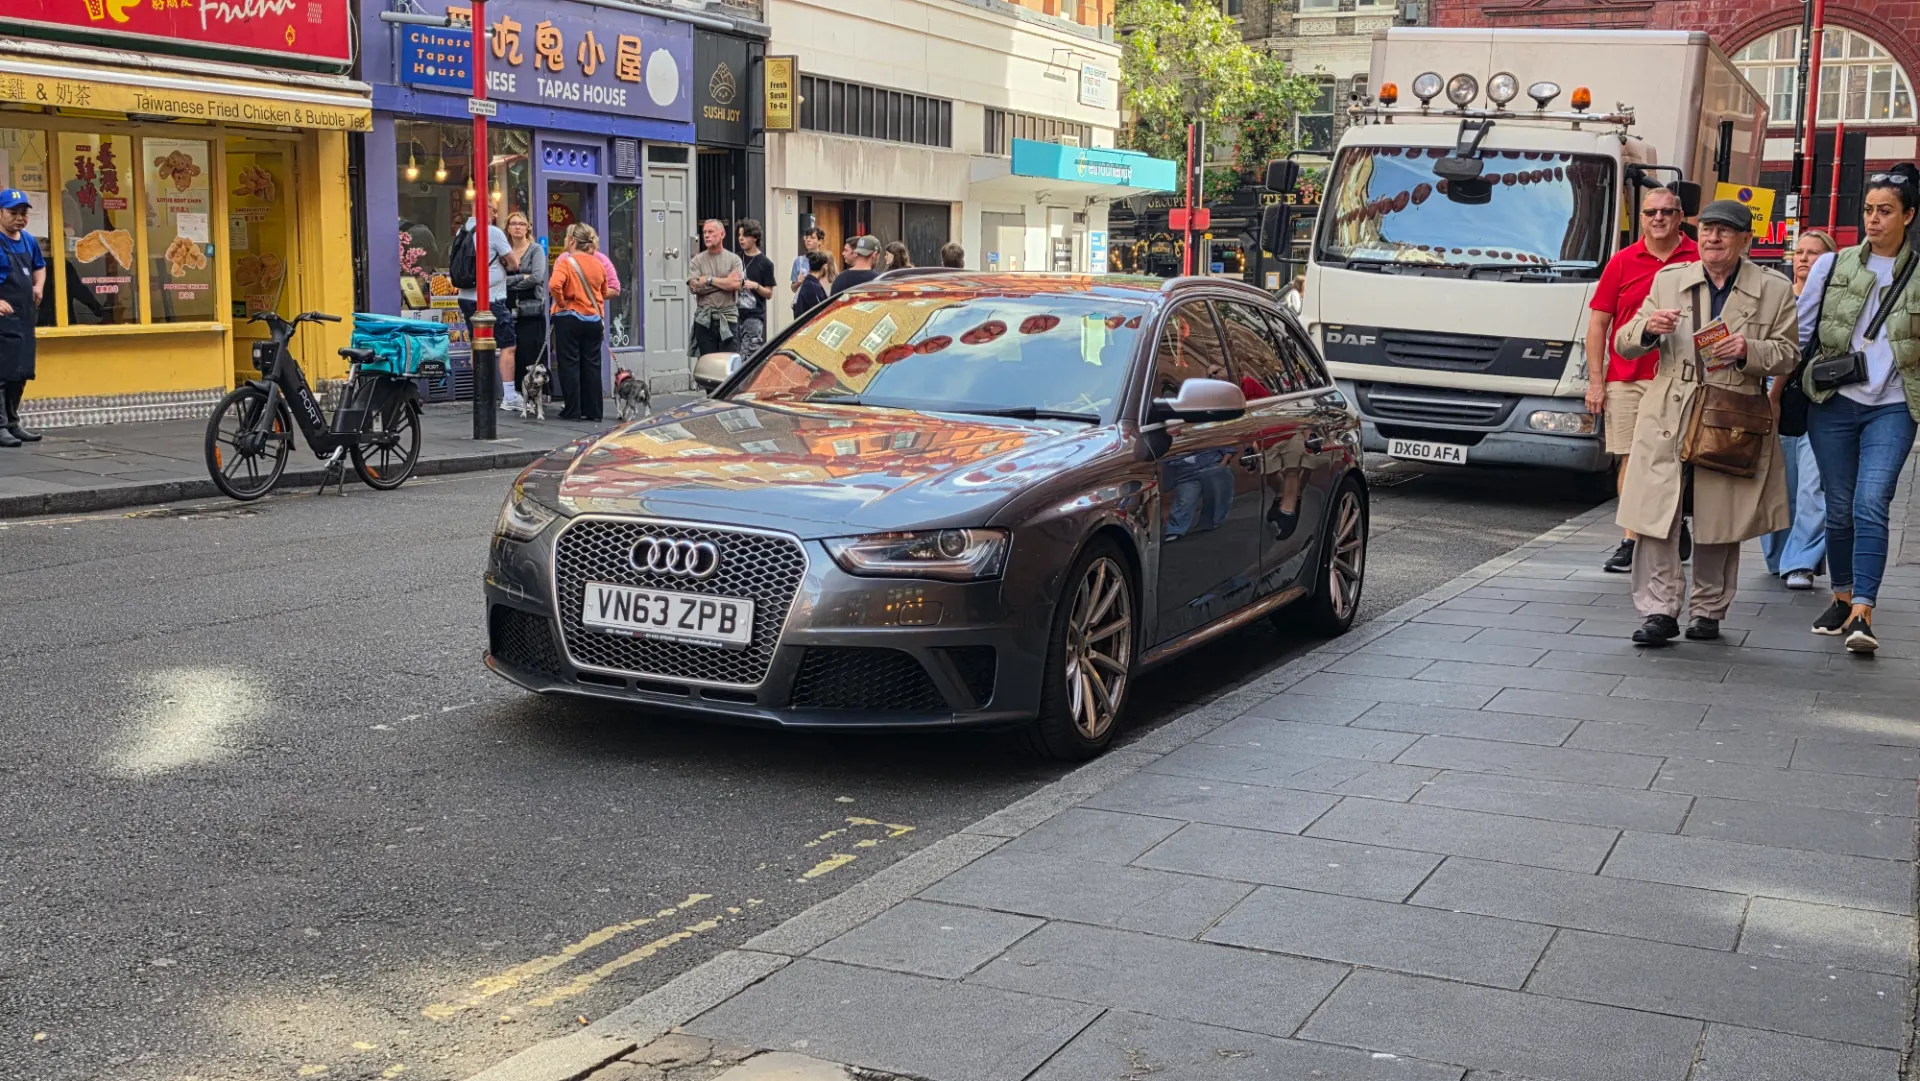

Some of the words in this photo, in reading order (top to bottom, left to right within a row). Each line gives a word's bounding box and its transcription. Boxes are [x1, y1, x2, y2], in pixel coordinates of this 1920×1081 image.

[411, 32, 471, 48] Chinese
[446, 6, 642, 83] 吃鬼小屋
[416, 48, 463, 63] Tapas
[413, 62, 466, 78] House
[486, 70, 516, 93] NESE
[537, 77, 580, 101] TAPAS
[583, 84, 627, 107] HOUSE
[770, 81, 787, 89] Fresh
[36, 82, 48, 101] &
[56, 82, 92, 107] 奶茶
[769, 91, 787, 100] Sushi
[133, 93, 204, 115] Taiwanese
[208, 101, 239, 119] Fried
[243, 104, 291, 122] Chicken
[294, 109, 302, 123] &
[306, 109, 346, 127] Bubble
[347, 113, 366, 129] Tea
[703, 105, 726, 120] SUSHI
[727, 108, 741, 122] JOY
[1088, 162, 1133, 182] eurochange
[1326, 332, 1377, 346] DAF
[1697, 328, 1727, 345] LONDON
[1521, 347, 1564, 360] LF
[298, 389, 321, 425] PORT
[1393, 440, 1430, 458] DX60
[1434, 445, 1460, 461] AFA
[598, 588, 669, 626] VN63
[677, 597, 738, 634] ZPB
